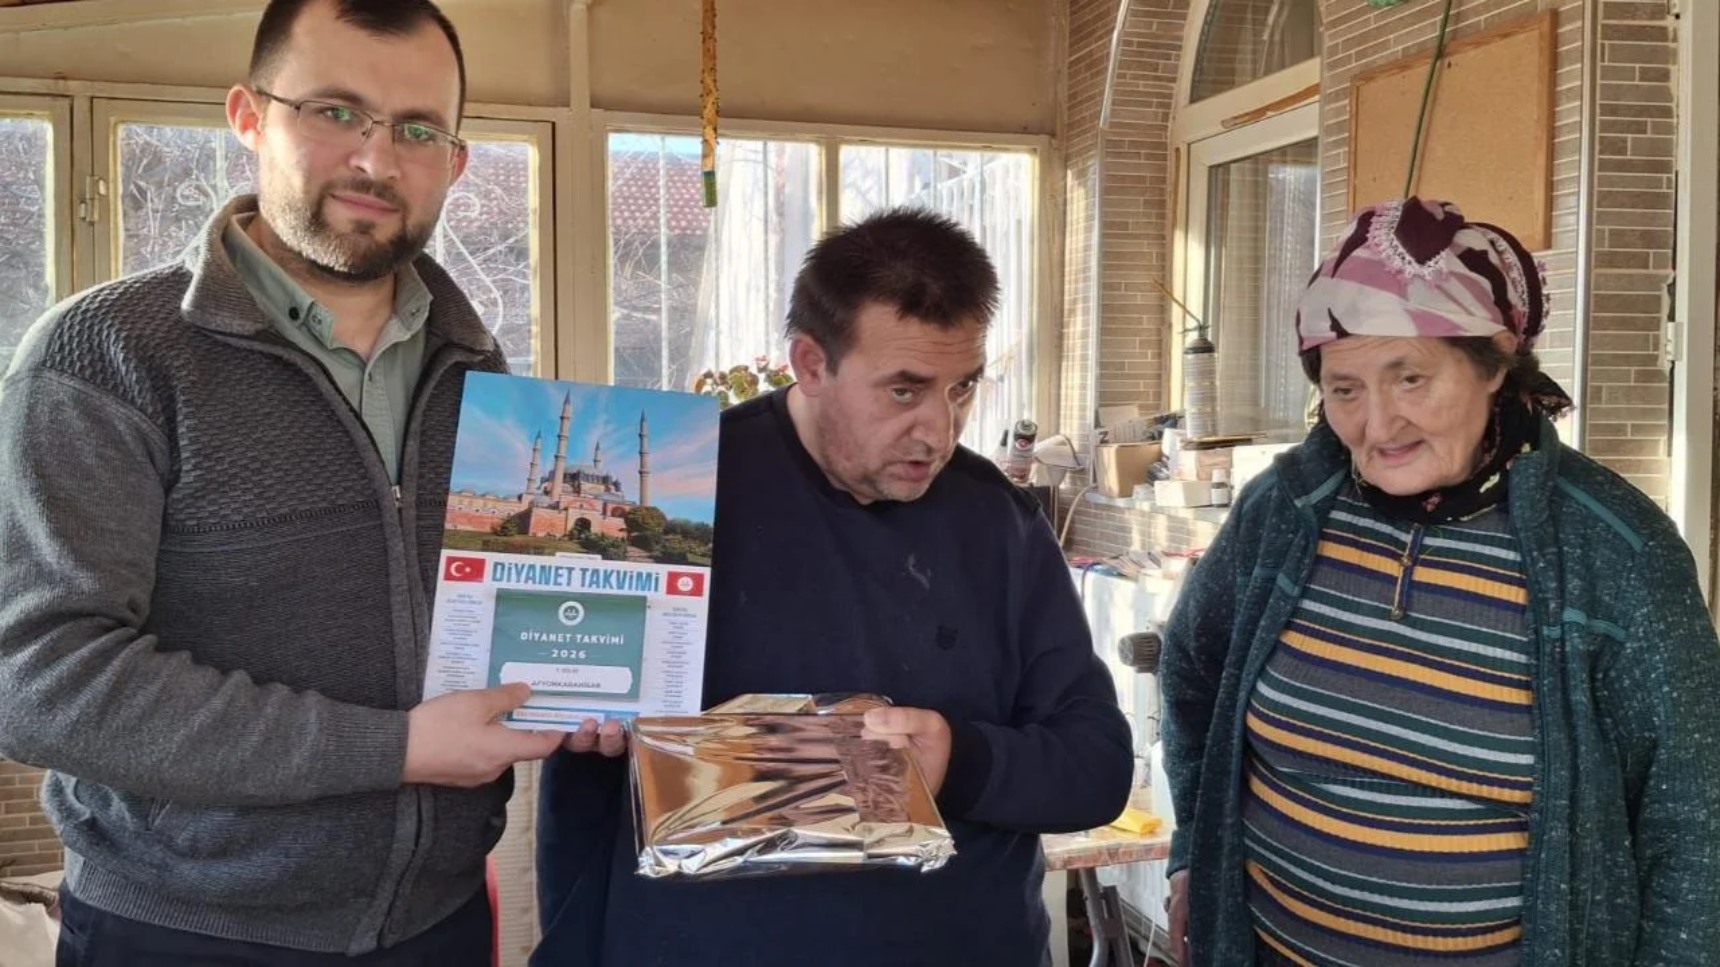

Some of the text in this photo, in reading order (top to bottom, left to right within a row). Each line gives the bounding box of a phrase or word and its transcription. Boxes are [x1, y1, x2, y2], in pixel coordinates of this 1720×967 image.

[520, 629, 625, 645] DİYANET TAKVİMİ
[551, 649, 587, 659] 2026
